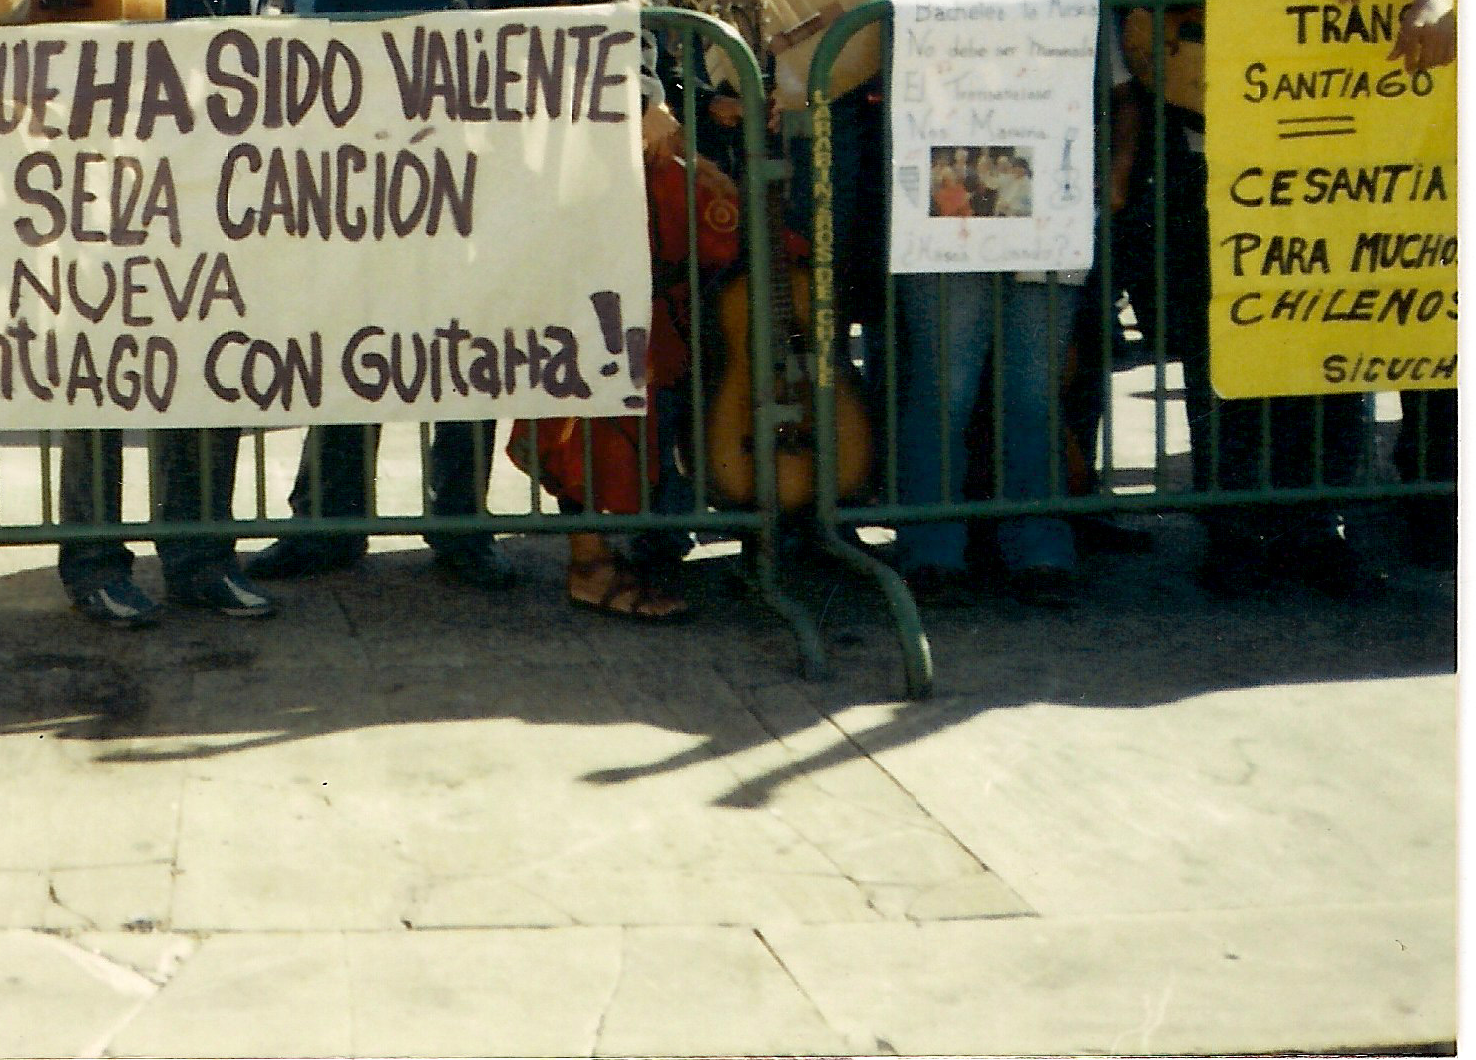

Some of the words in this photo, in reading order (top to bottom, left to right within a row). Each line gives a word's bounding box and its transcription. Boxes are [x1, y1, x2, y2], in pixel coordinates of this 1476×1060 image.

[67, 37, 196, 141] HA
[205, 29, 363, 136] SIDO
[1243, 61, 1434, 103] SANTIAGO
[14, 151, 182, 247] SERA
[9, 254, 246, 327] NUEVA
[1220, 232, 1331, 277] PARA
[1349, 232, 1458, 273] MUCHO
[204, 331, 323, 411] CON
